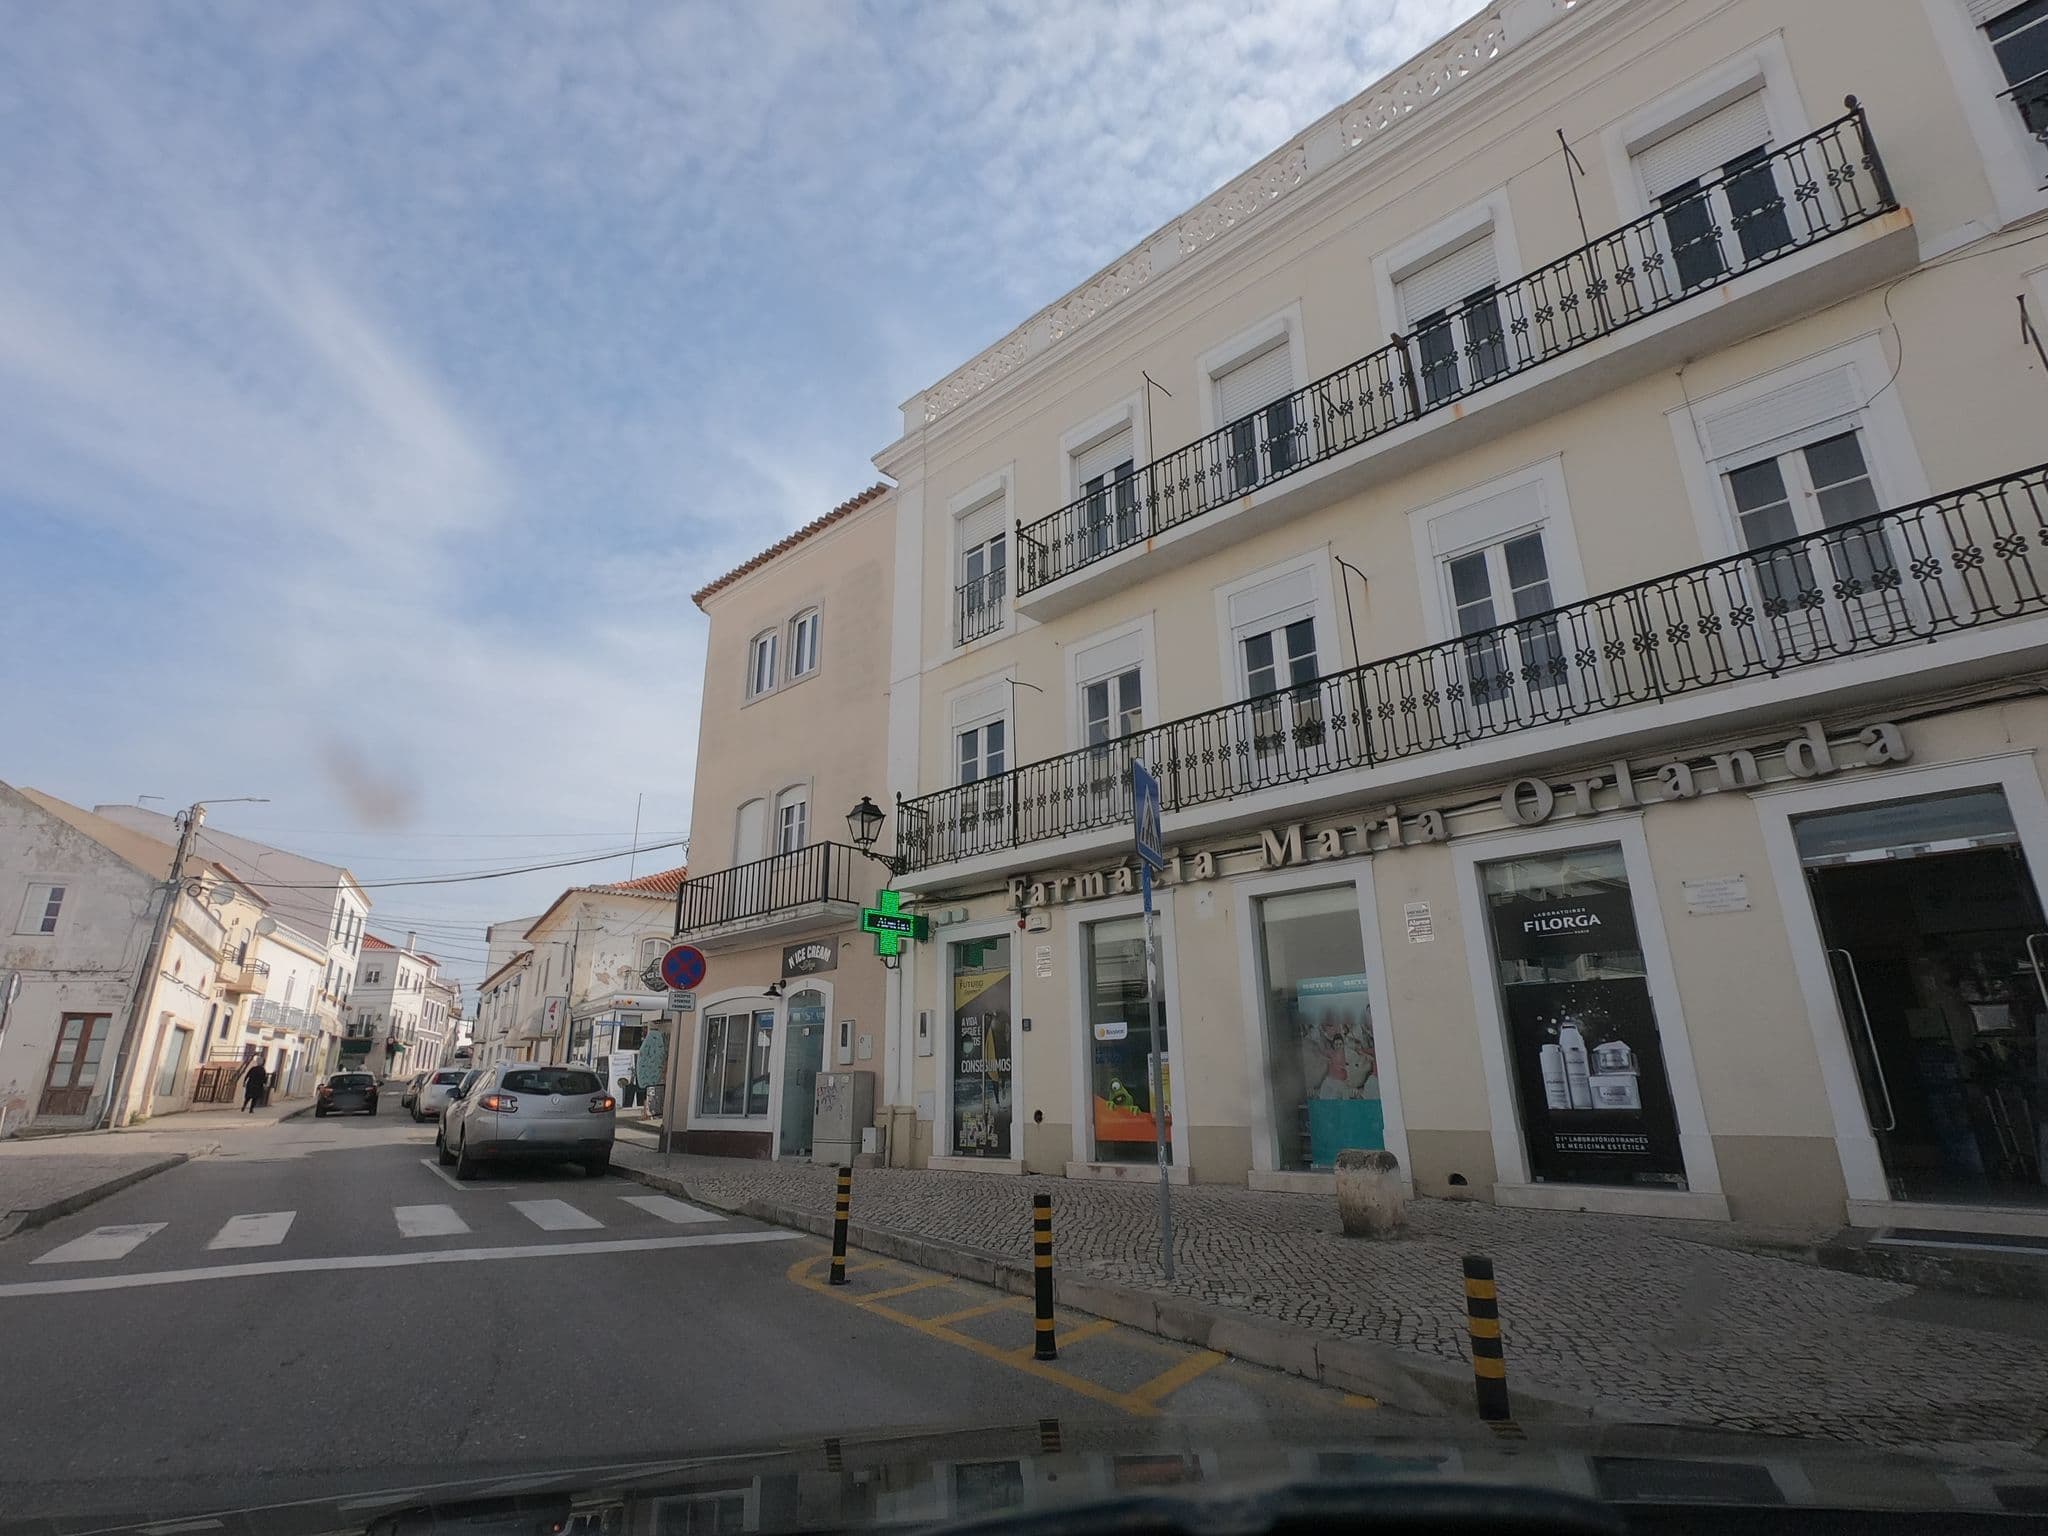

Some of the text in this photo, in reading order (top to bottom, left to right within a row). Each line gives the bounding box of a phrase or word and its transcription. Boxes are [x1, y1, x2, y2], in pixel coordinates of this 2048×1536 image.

[1260, 804, 1449, 868] Maria
[1501, 719, 1914, 826] Orlanda
[1523, 914, 1602, 933] FILORGA
[806, 945, 831, 962] CREAM
